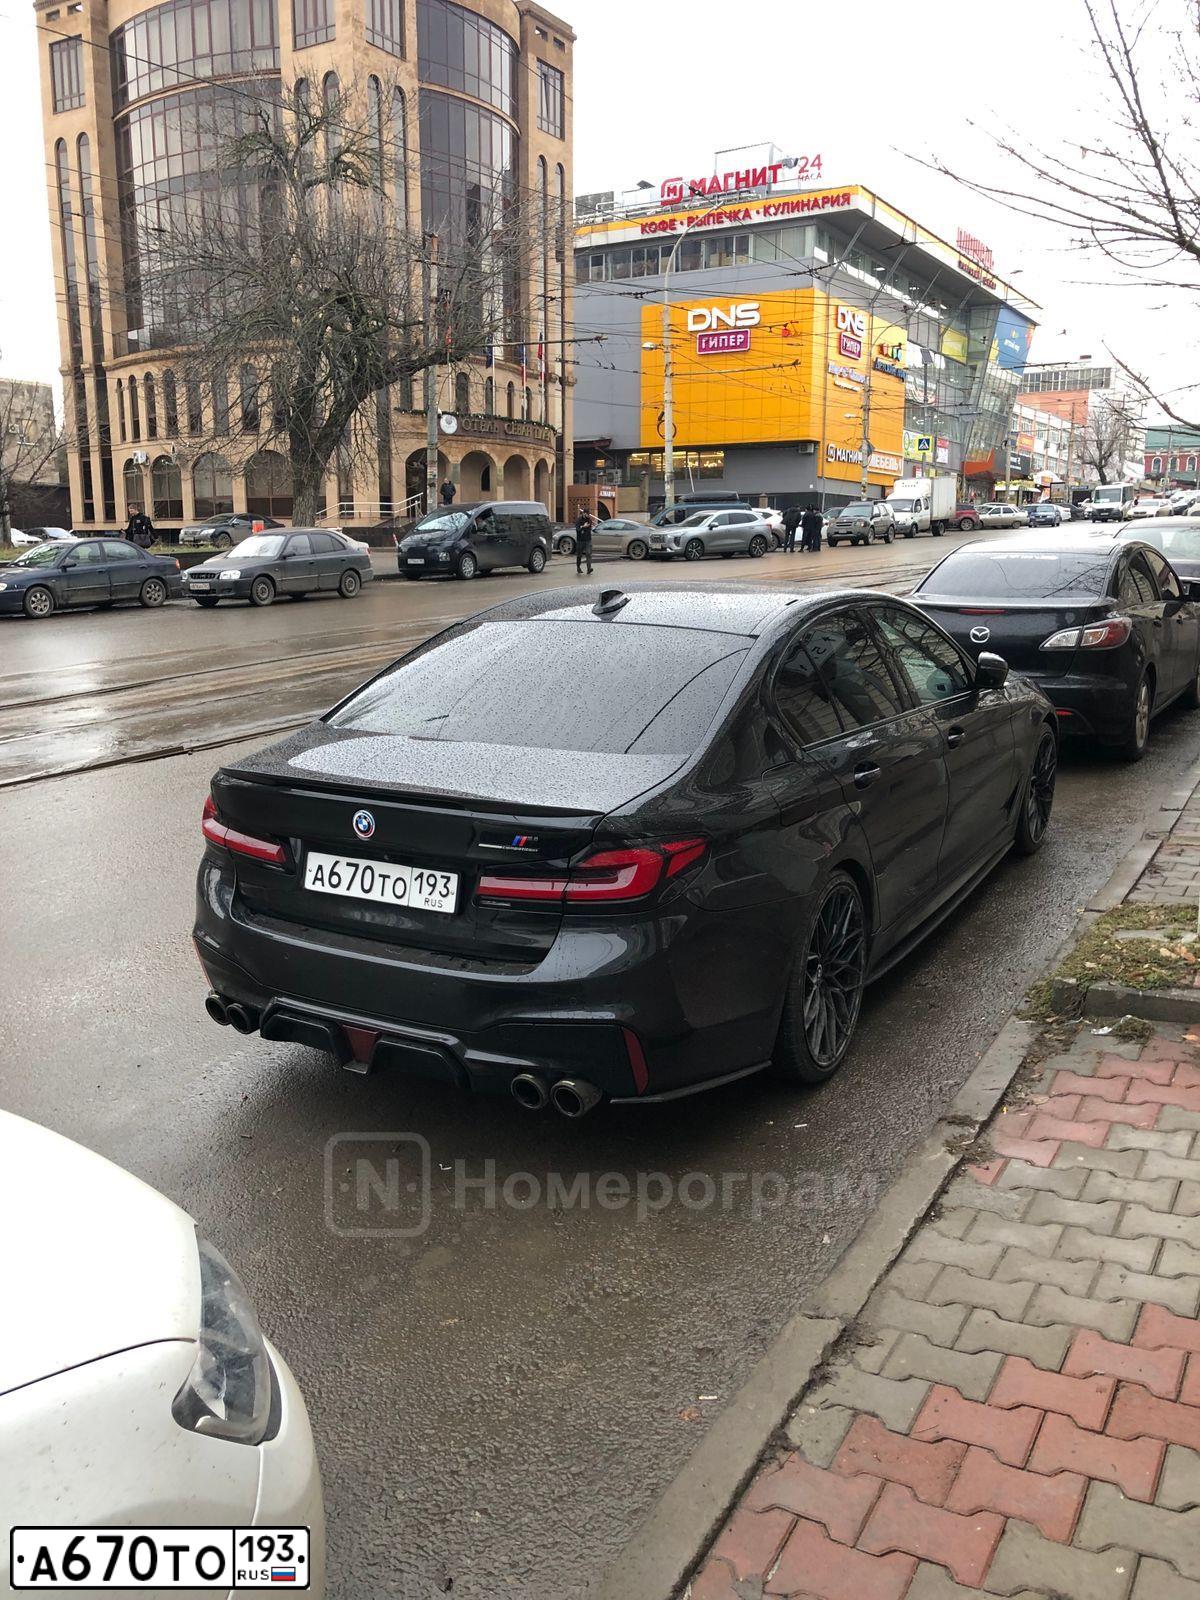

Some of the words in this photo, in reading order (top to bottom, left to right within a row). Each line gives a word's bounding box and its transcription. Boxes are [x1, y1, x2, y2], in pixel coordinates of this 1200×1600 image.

[799, 153, 823, 174] 24
[690, 163, 783, 198] МАГНИТ
[641, 218, 678, 235] КОФЕ
[763, 192, 851, 217] КУЛИНАРИЯ
[687, 302, 760, 331] DNS
[837, 301, 867, 337] DNS
[702, 335, 745, 349] ГИПЕР
[312, 860, 408, 900] А670ТО
[414, 872, 451, 899] 193
[424, 897, 444, 909] RUS
